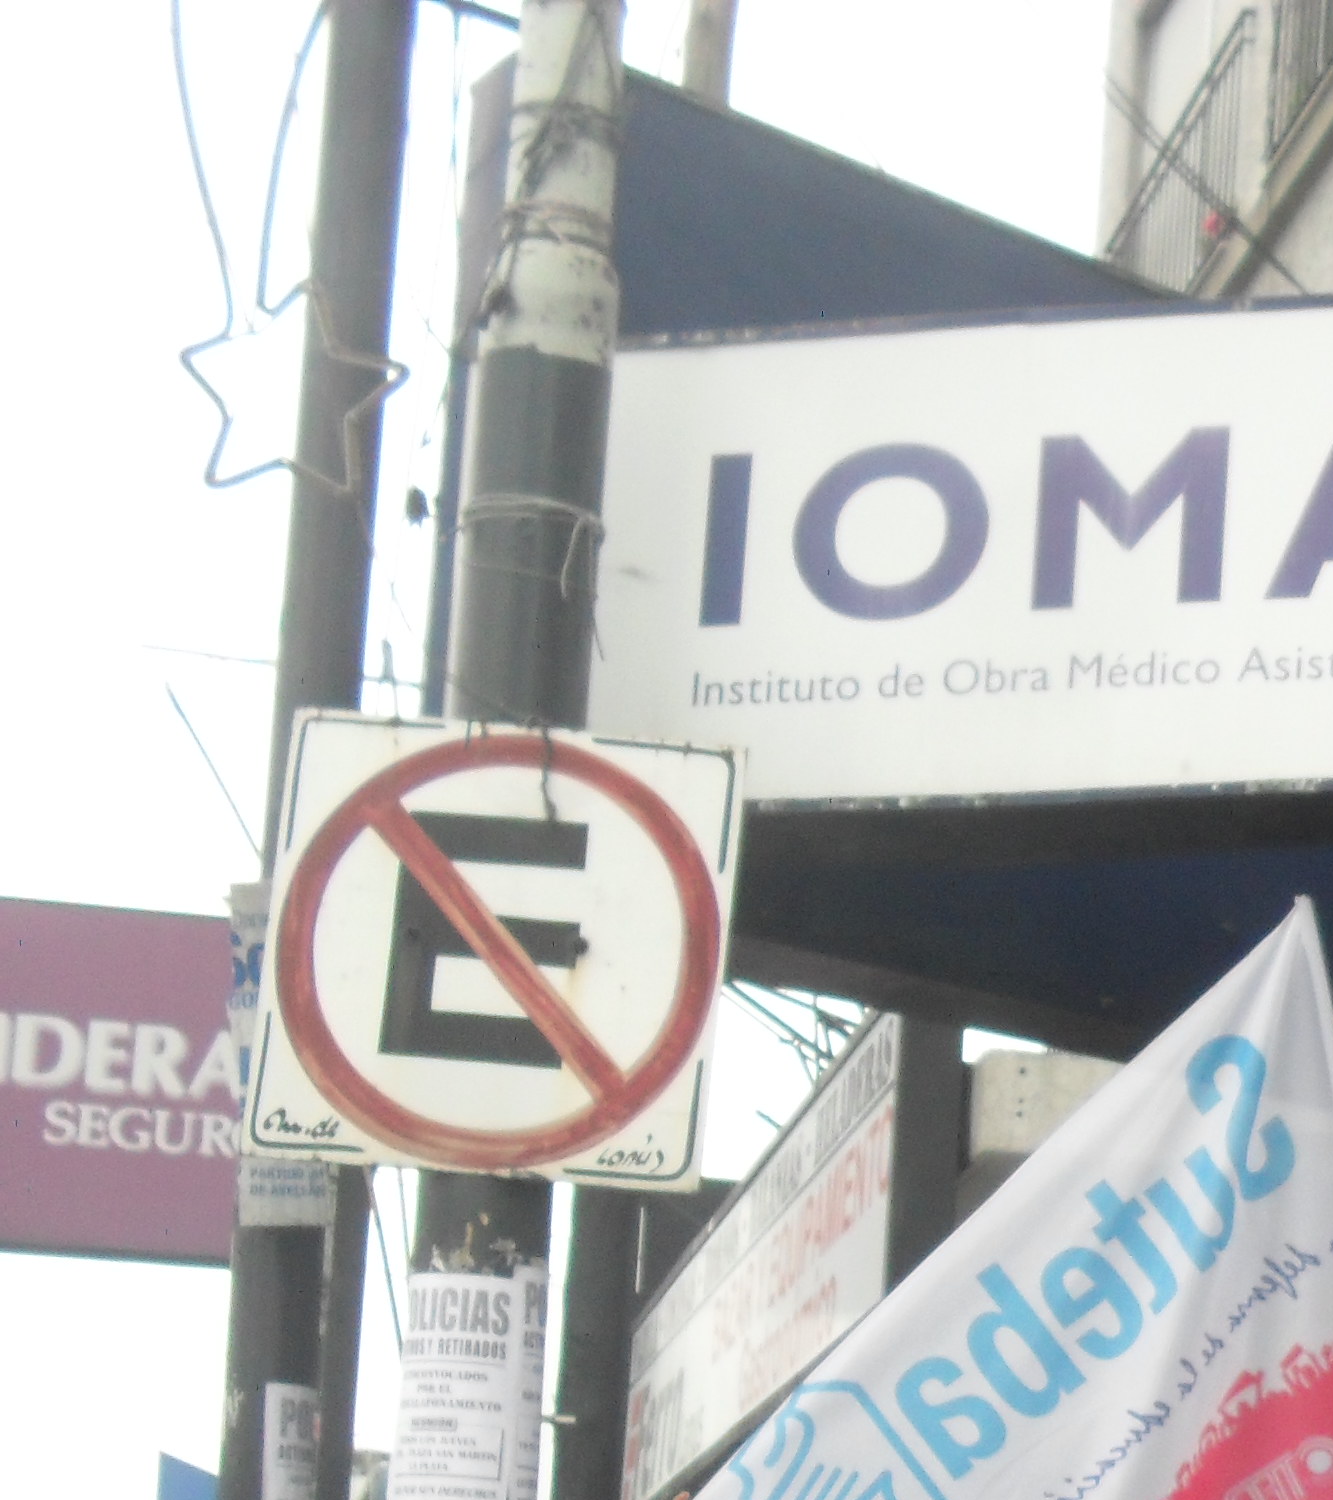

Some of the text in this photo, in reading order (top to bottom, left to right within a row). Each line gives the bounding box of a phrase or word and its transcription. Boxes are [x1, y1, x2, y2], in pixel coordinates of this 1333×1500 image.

[691, 668, 861, 708] Instituto
[877, 661, 925, 700] de
[942, 655, 1050, 697] Obra
[1069, 647, 1221, 691] Médico
[377, 809, 589, 1070] E
